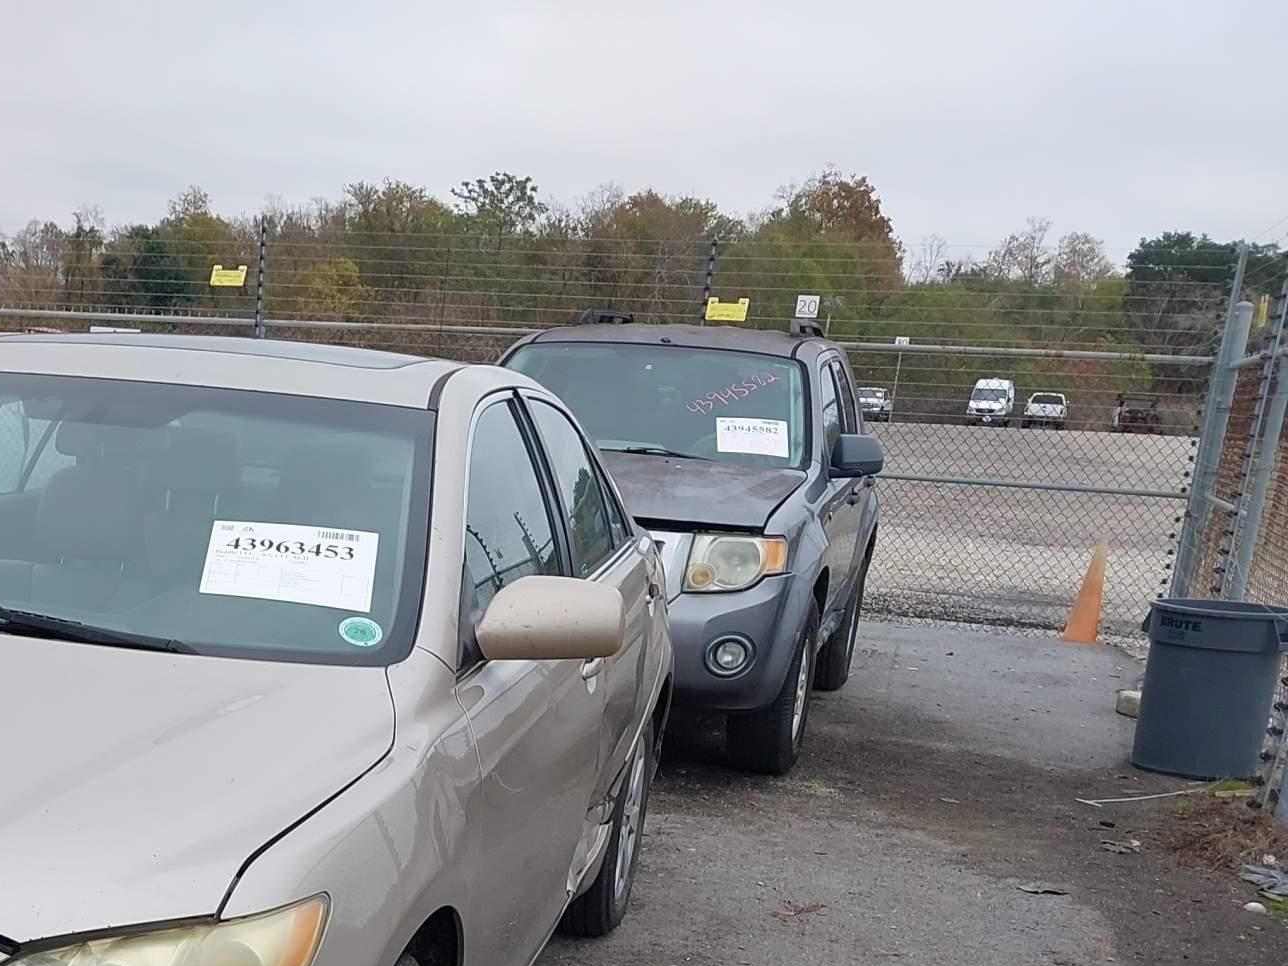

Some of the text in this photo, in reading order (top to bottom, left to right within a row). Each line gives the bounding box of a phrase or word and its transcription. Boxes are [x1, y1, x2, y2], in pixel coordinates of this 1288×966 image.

[798, 300, 817, 313] 20
[686, 373, 780, 415] 43945582
[226, 537, 355, 561] 43963453
[1160, 616, 1202, 632] BRUTE
